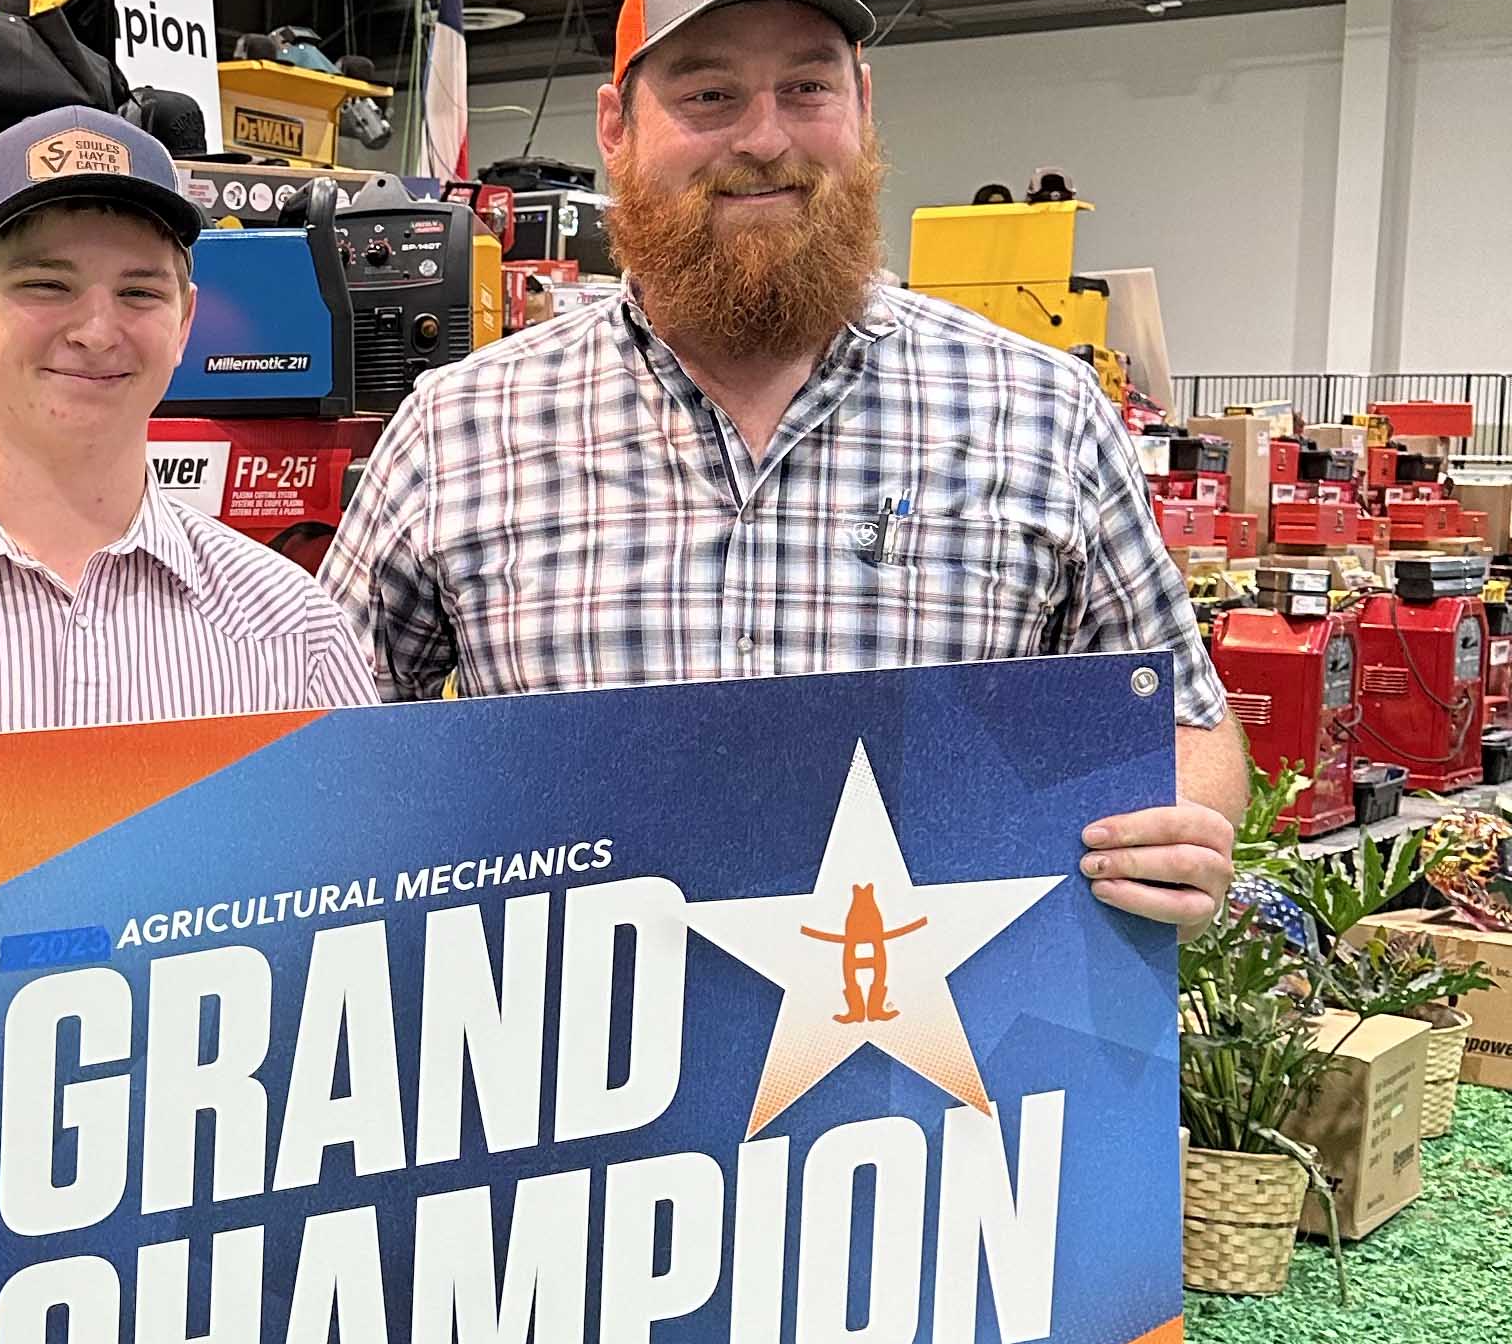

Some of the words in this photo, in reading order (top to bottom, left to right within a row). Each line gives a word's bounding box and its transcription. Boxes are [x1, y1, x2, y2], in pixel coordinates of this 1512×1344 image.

[115, 0, 208, 67] pion
[75, 140, 120, 155] SOULES
[236, 112, 301, 152] DEWALT
[79, 150, 104, 161] HAY
[208, 356, 287, 372] Millermatic
[288, 355, 308, 370] 211
[234, 456, 316, 488] FP-25i
[116, 876, 385, 950] AGRICULTURAL
[394, 839, 615, 901] MECHANICS
